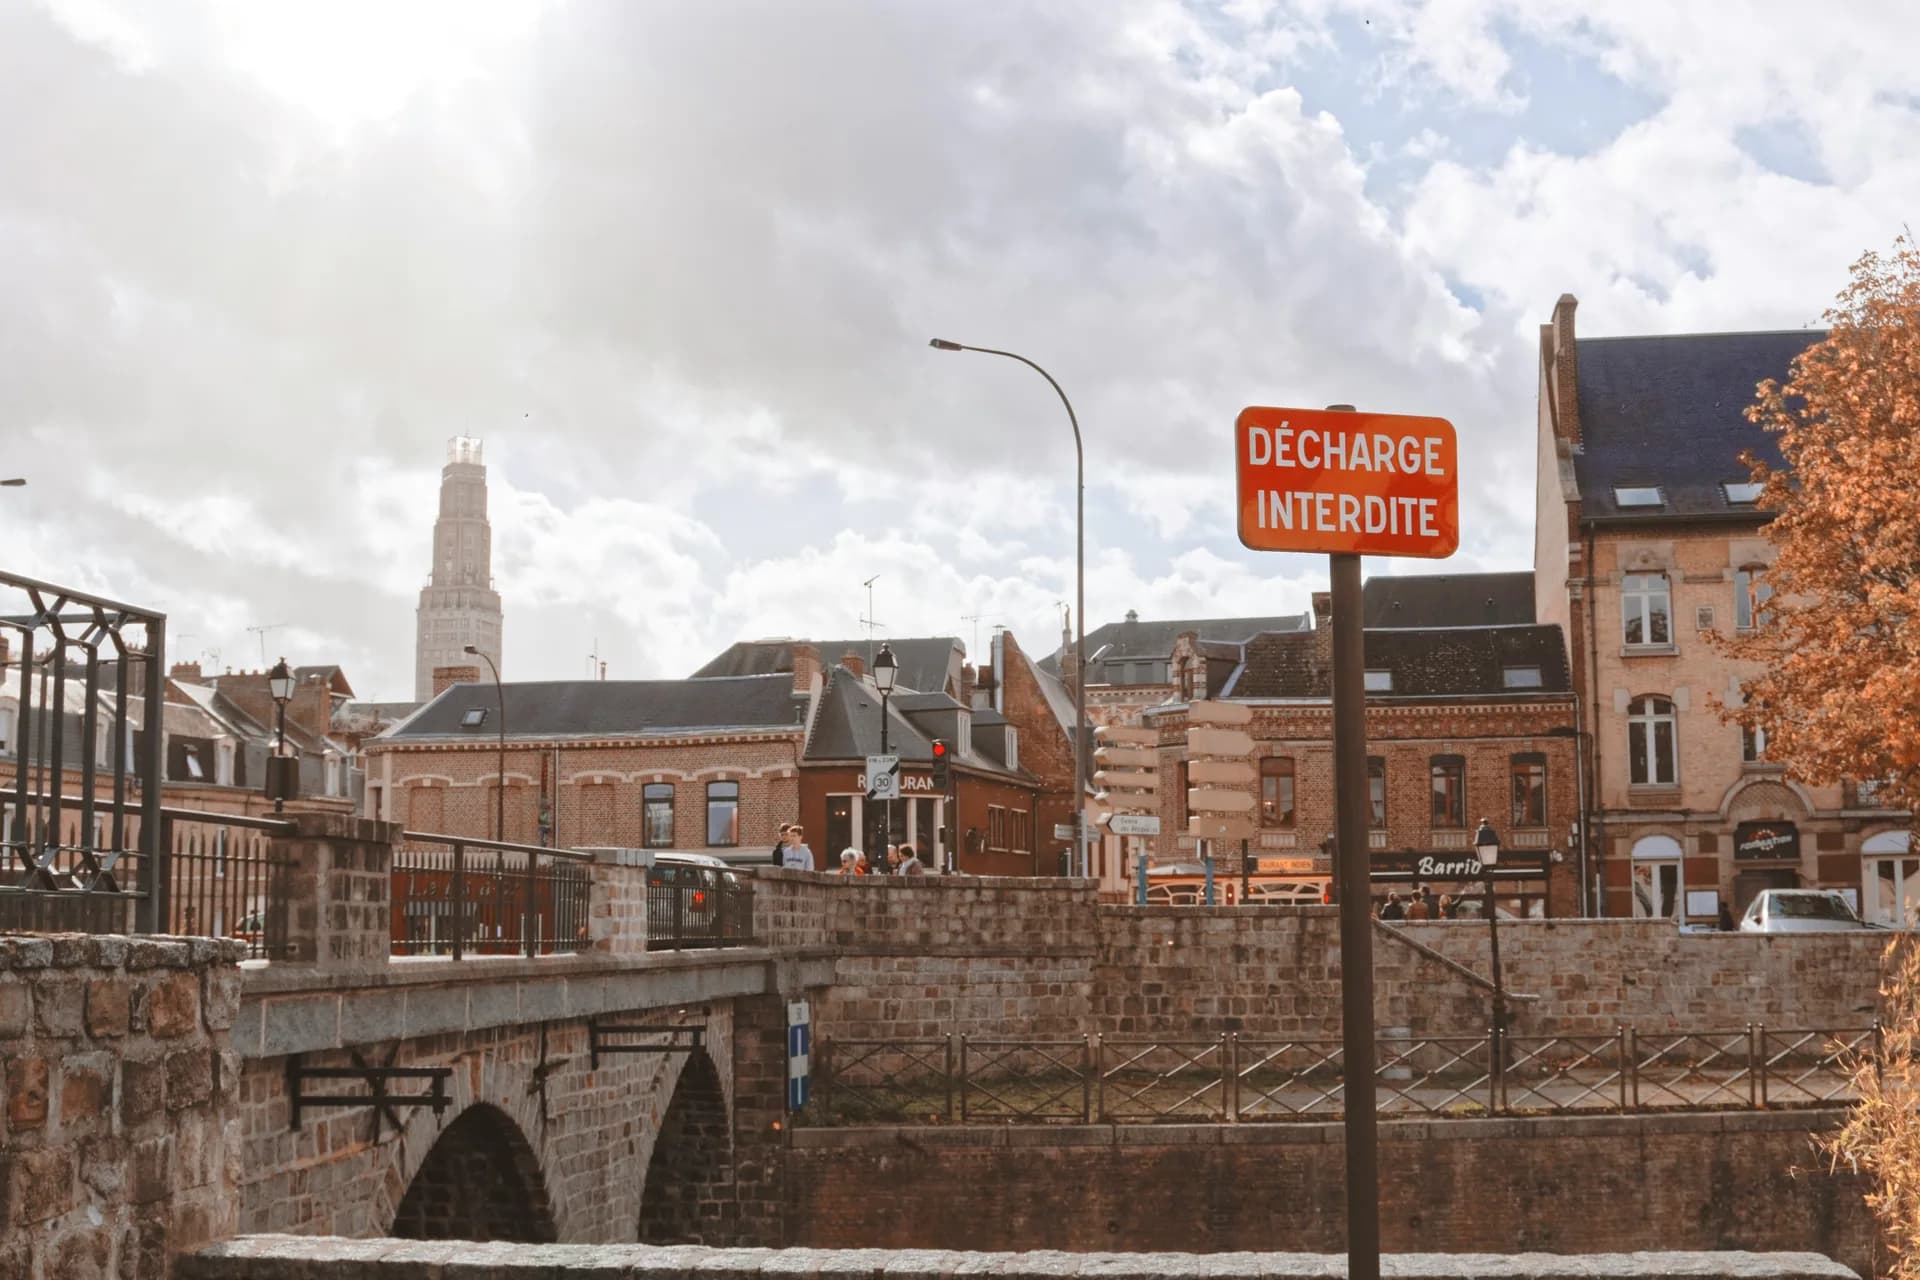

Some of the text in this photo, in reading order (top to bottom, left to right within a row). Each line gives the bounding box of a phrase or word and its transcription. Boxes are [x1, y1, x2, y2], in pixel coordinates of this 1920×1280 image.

[1248, 420, 1445, 475] DÉCHARGE
[1257, 489, 1440, 537] INTERDITE
[876, 778, 889, 787] 30
[1418, 855, 1482, 876] Barrio
